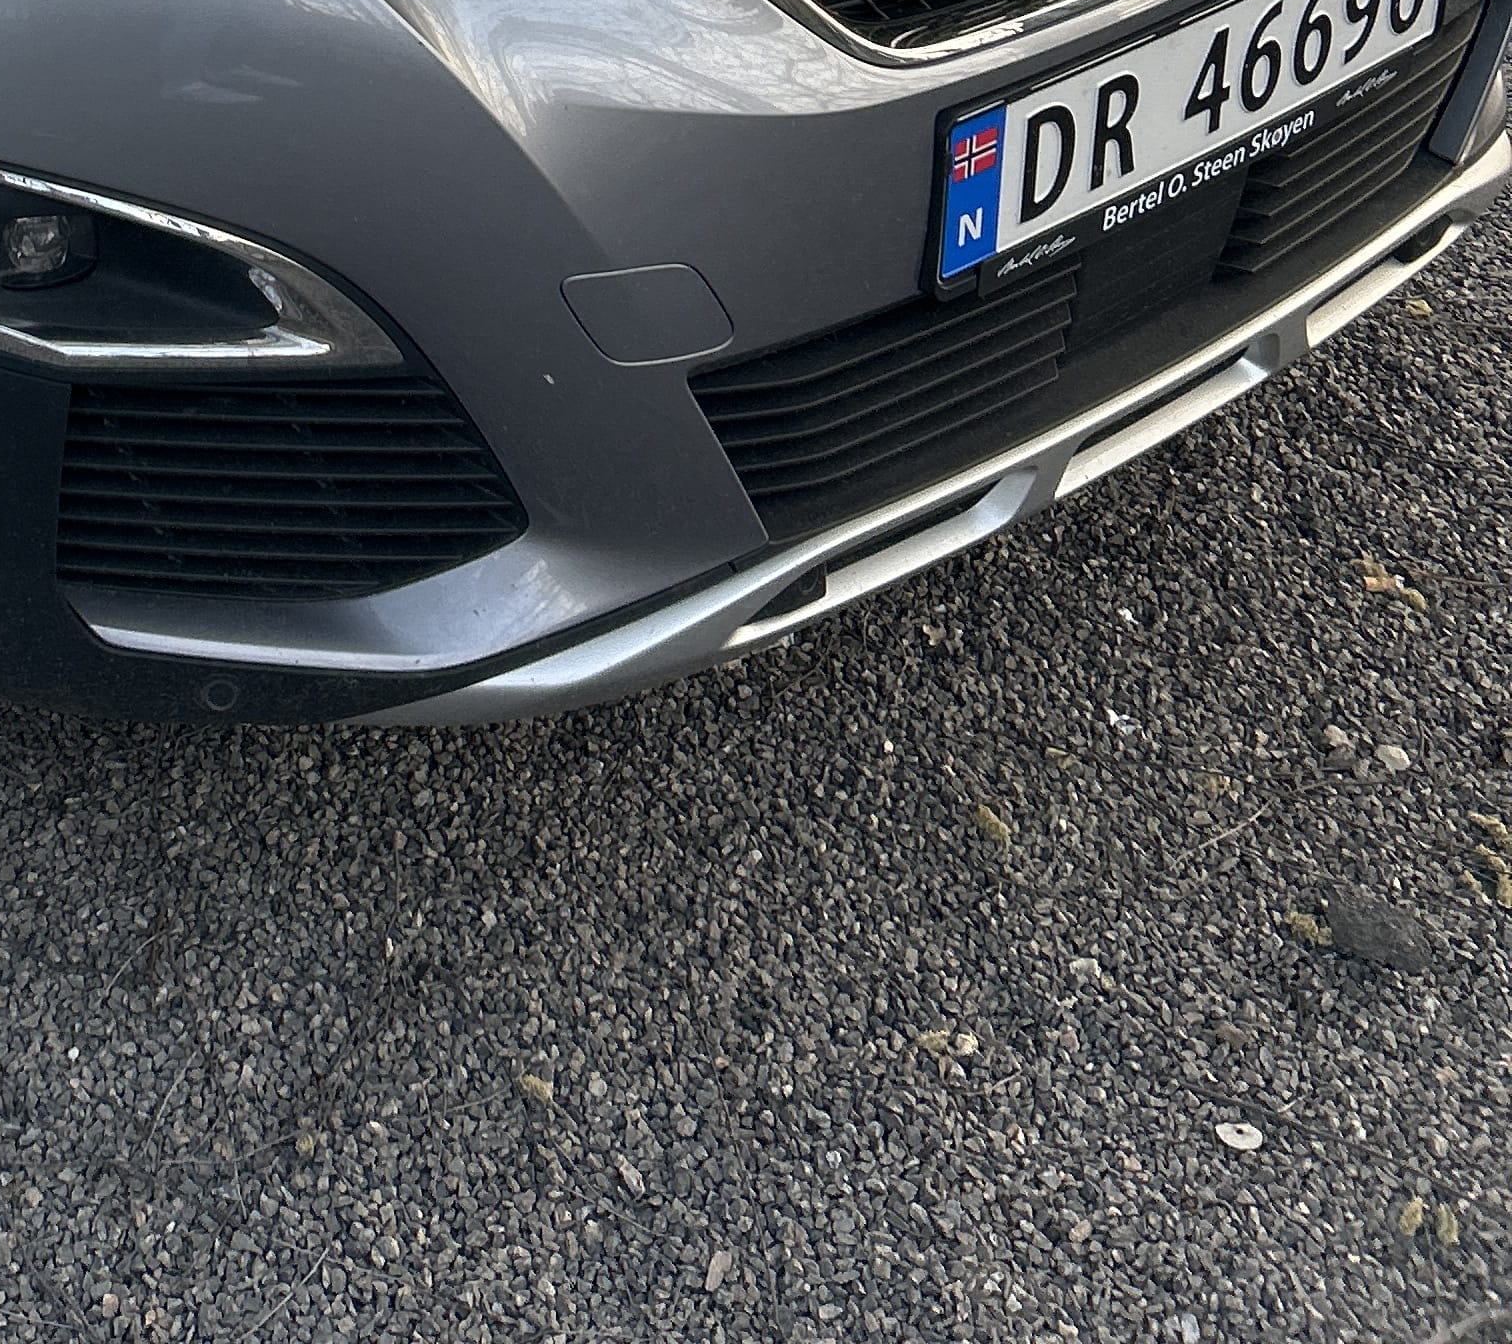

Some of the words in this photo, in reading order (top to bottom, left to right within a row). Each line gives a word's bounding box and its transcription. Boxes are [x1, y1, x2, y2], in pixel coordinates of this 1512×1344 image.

[1019, 72, 1141, 225] DR
[1101, 181, 1165, 232] Bertel
[1167, 172, 1188, 199] O.
[1191, 147, 1246, 189] Steen
[1249, 109, 1316, 159] Skøyen
[957, 207, 983, 248] N
